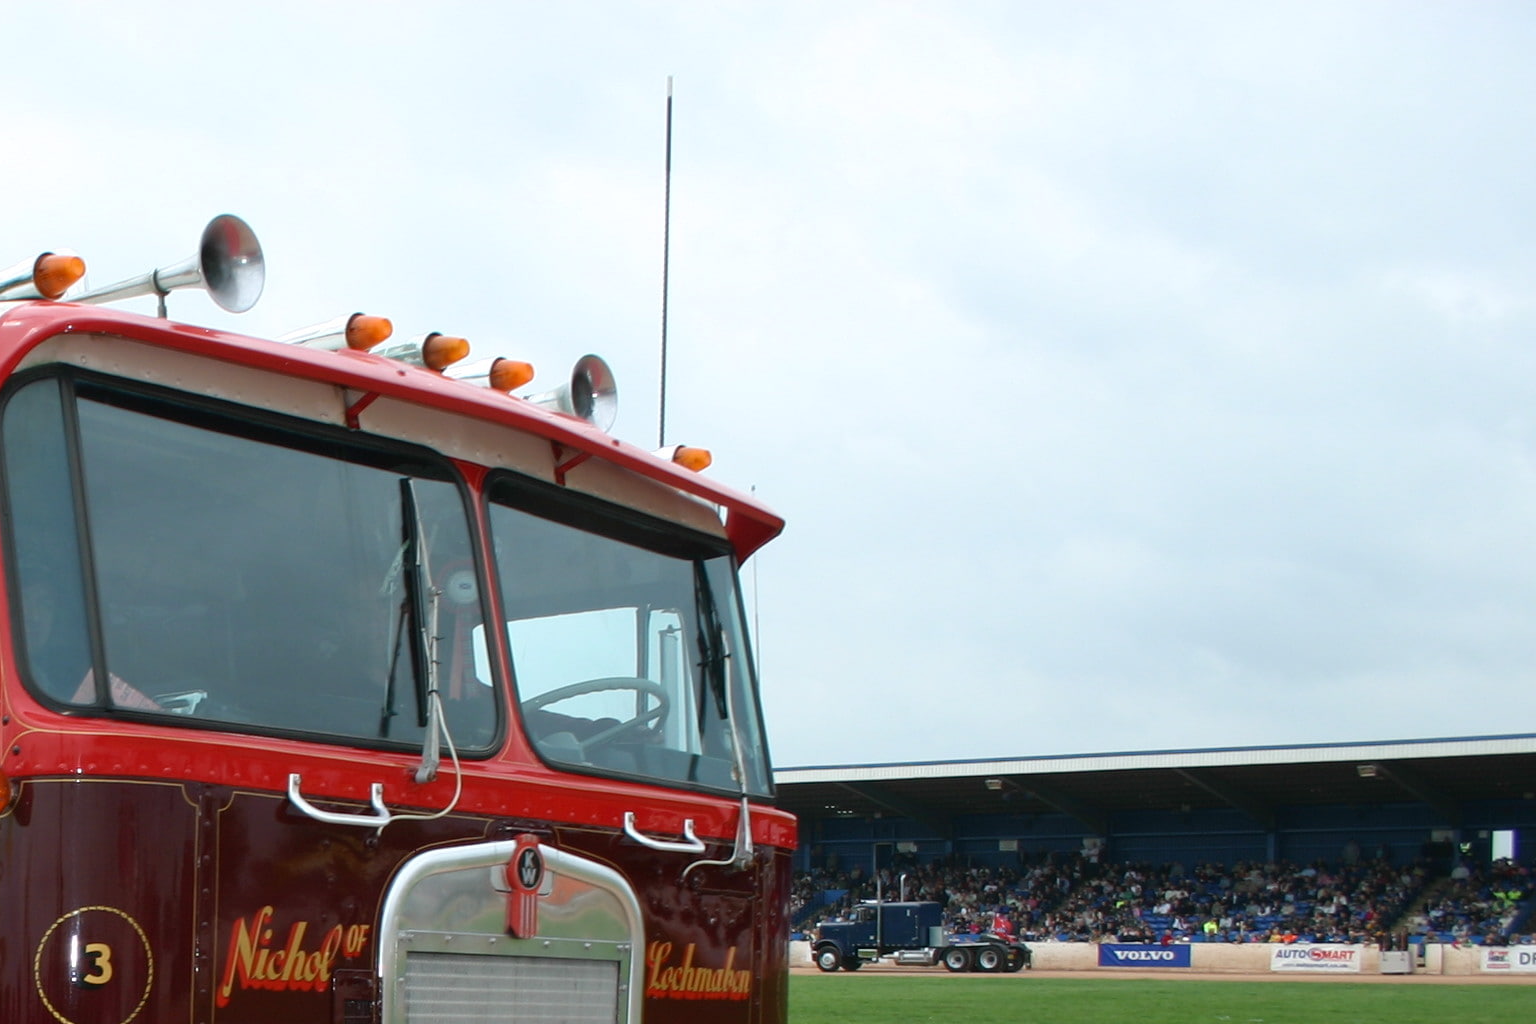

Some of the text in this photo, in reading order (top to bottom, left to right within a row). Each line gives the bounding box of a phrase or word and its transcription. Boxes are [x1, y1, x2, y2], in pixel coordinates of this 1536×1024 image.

[83, 942, 113, 986] 3
[217, 905, 751, 1006] Nichol OF Lochmaben
[1114, 950, 1175, 961] VOLVO
[1275, 948, 1355, 961] AUTOSMART
